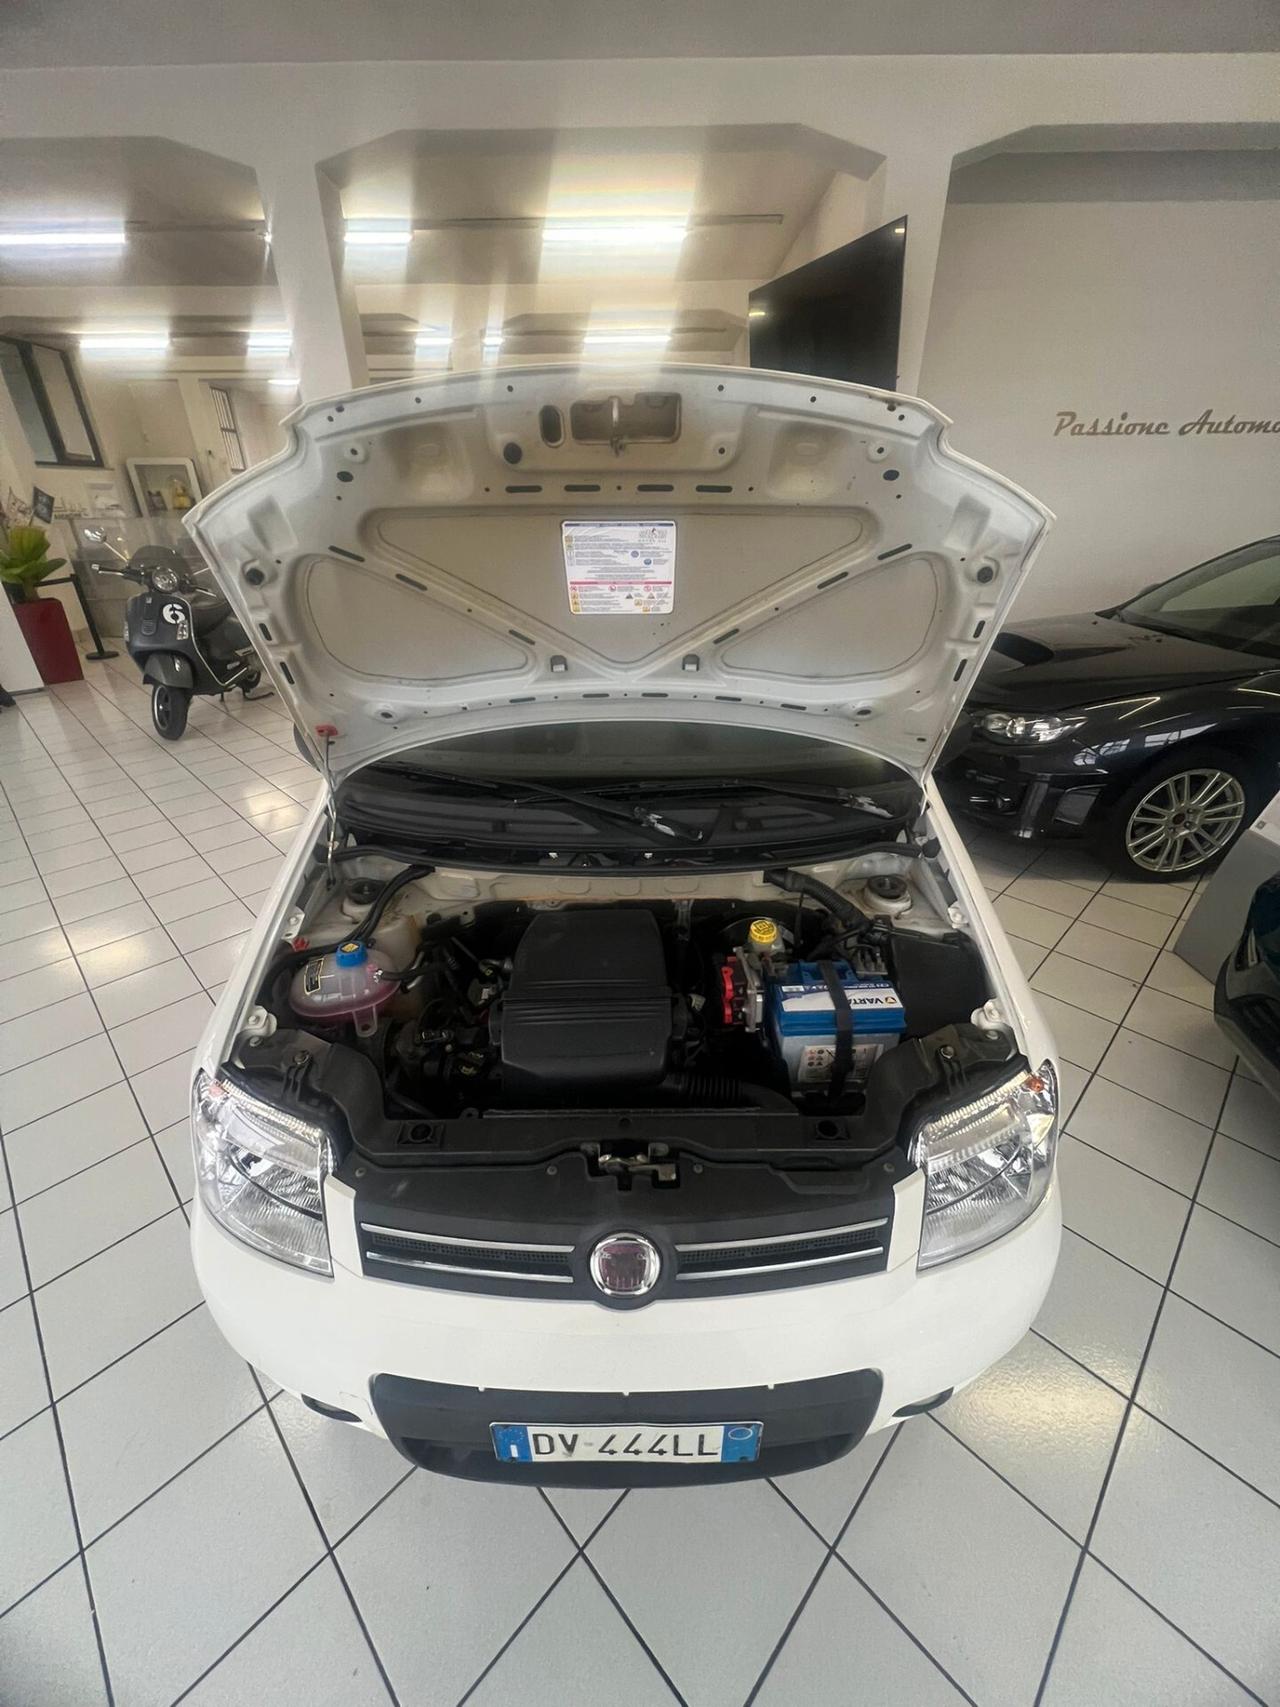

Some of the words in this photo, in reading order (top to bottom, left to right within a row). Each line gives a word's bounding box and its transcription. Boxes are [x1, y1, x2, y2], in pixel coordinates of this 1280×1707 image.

[1053, 411, 1170, 436] Passione
[162, 603, 186, 624] 6
[532, 1433, 579, 1456] DV
[598, 1432, 719, 1457] 444LL
